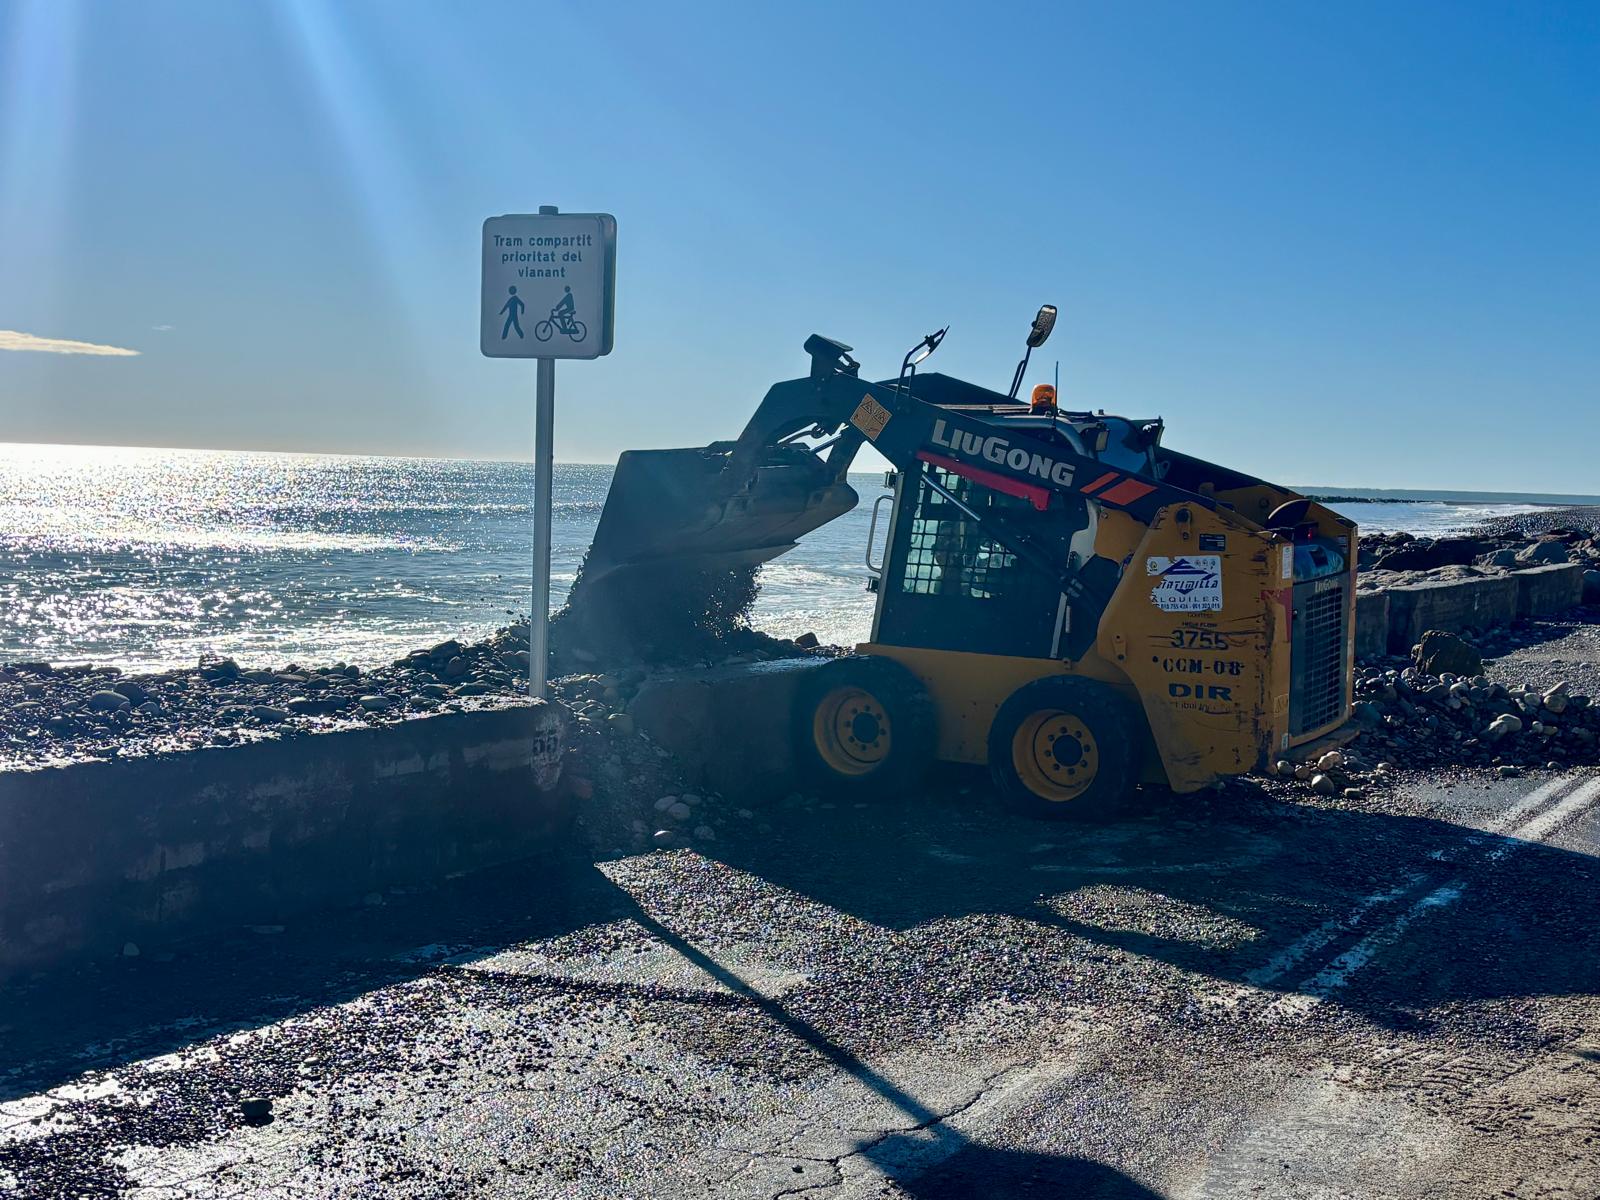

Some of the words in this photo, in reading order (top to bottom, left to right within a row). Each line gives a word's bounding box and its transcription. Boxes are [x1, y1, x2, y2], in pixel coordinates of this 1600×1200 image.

[493, 235, 522, 247] Tram
[528, 234, 592, 248] compartit
[502, 251, 556, 264] prioritat
[562, 251, 582, 262] del
[518, 267, 566, 278] vianant
[1168, 683, 1233, 701] DIR
